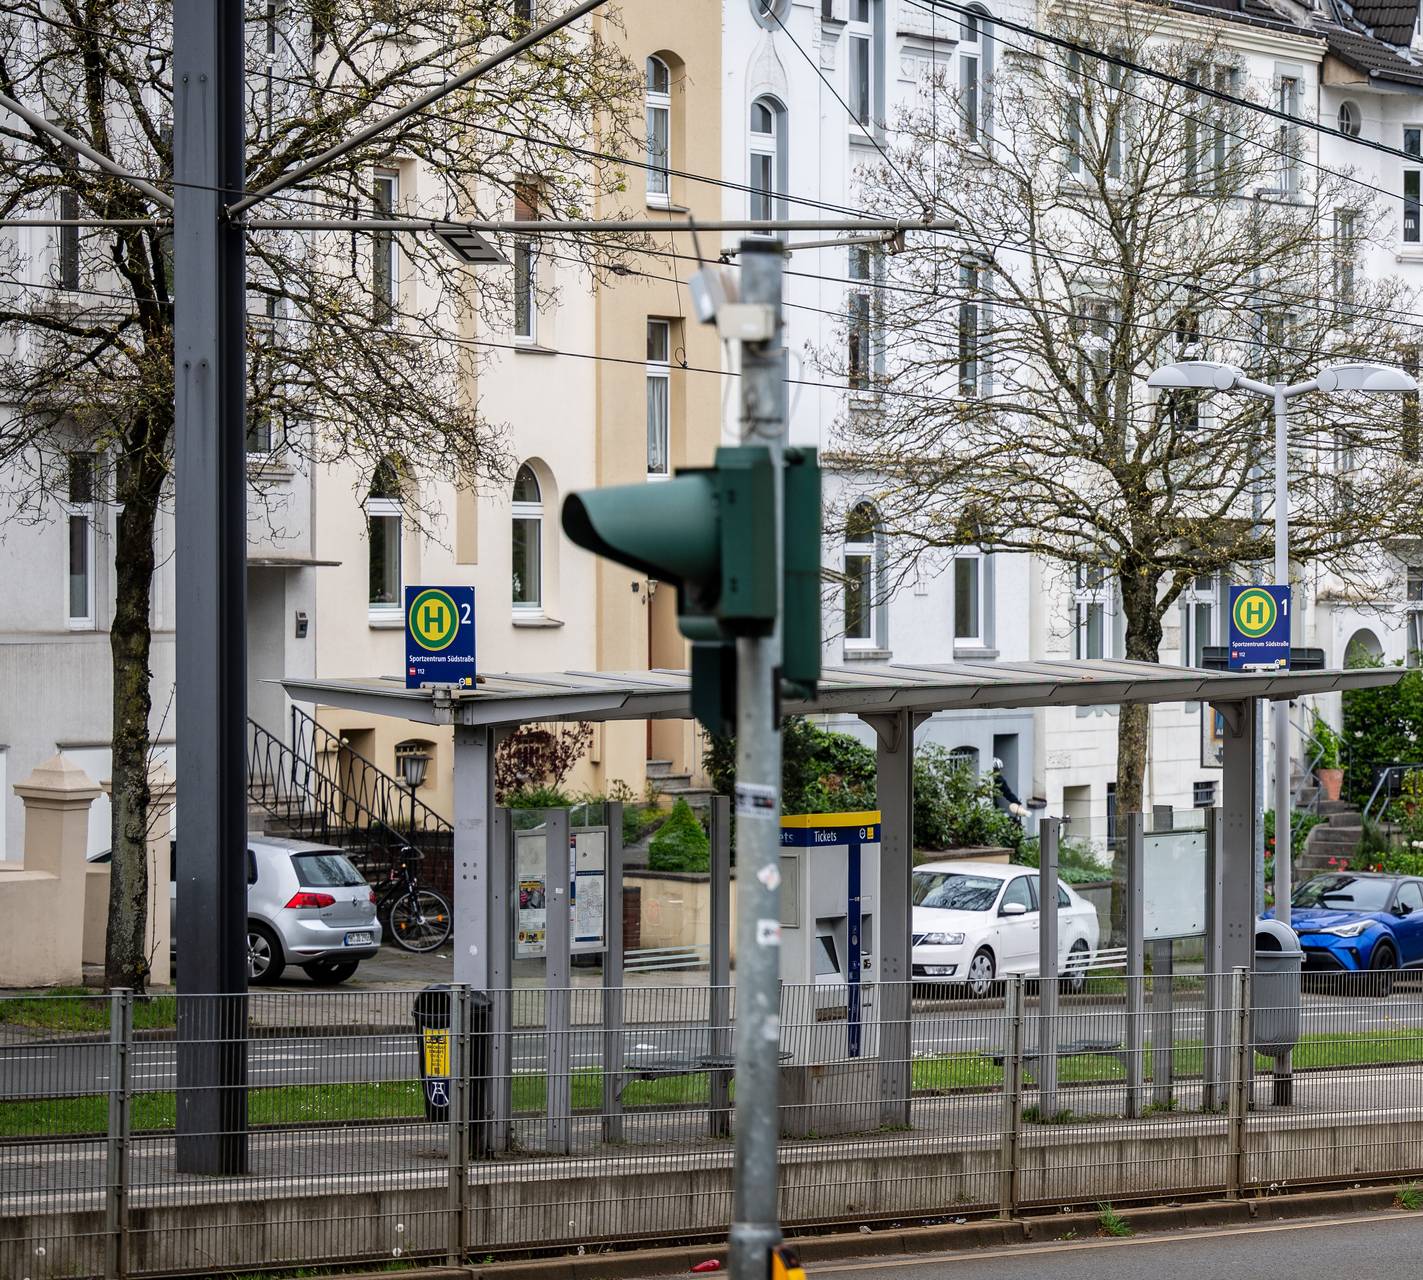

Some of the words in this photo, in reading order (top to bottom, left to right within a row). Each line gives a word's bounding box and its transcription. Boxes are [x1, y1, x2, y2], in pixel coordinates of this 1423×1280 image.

[440, 234, 498, 262] E
[424, 605, 444, 633] H
[461, 603, 471, 624] 2
[1246, 601, 1264, 624] H
[1281, 598, 1288, 616] 1
[409, 655, 446, 663] Sportzentrum
[814, 829, 838, 843] Tickets
